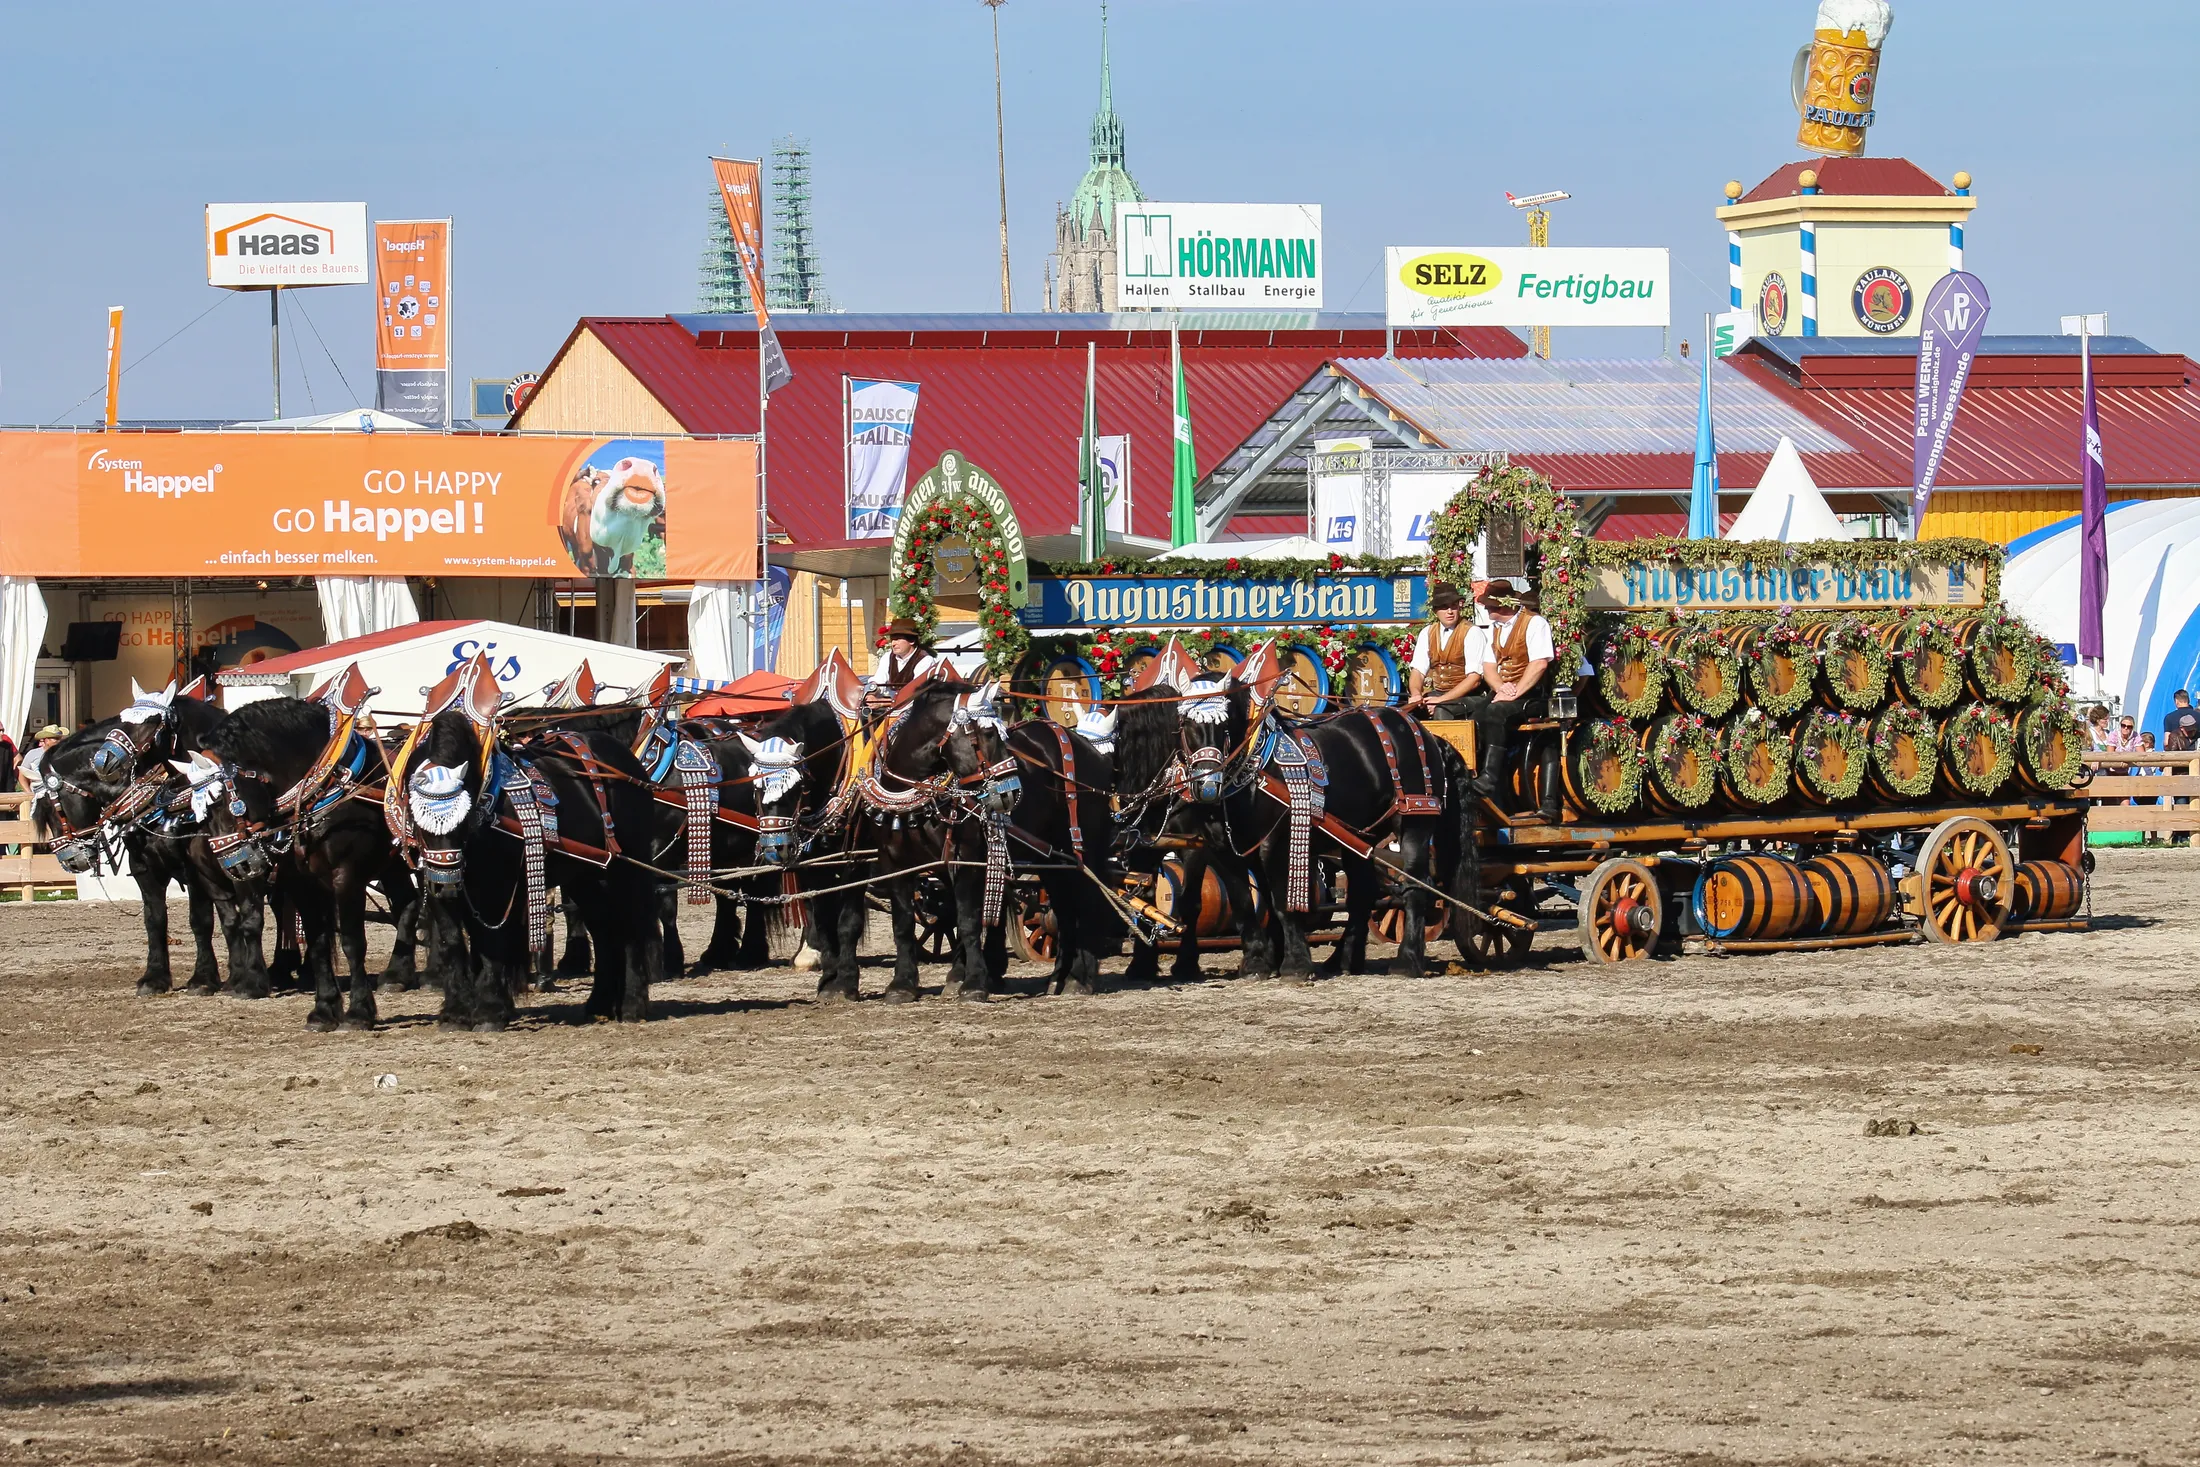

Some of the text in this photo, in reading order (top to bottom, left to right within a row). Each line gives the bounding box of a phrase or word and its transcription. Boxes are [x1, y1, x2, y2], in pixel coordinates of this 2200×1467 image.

[1178, 230, 1315, 278] HÖRMANN
[239, 263, 363, 275] Die Vielfalt des Bauens.
[1415, 264, 1487, 285] SELZ
[1125, 284, 1316, 299] Hallen Stallbau Energie
[1517, 274, 1654, 304] Fertigbau
[1855, 269, 1909, 294] PAULANER
[1430, 299, 1493, 321] Generationen
[1861, 315, 1906, 332] MÜNCHEN
[1916, 329, 1934, 437] Paul WERNER
[1915, 352, 1971, 502] Klauenpflegestände
[97, 457, 142, 473] System
[363, 470, 502, 496] GO HAPPY
[273, 508, 315, 532] GO
[968, 470, 1025, 564] anno 1901
[220, 550, 271, 564] einfach
[275, 550, 319, 564] besser
[322, 550, 378, 564] melken.
[444, 556, 557, 568] www.system-happel.de
[1064, 577, 1378, 624] Augustiner-Bräu
[120, 632, 142, 647] GO
[446, 640, 521, 681] Eis
[1357, 668, 1375, 697] E
